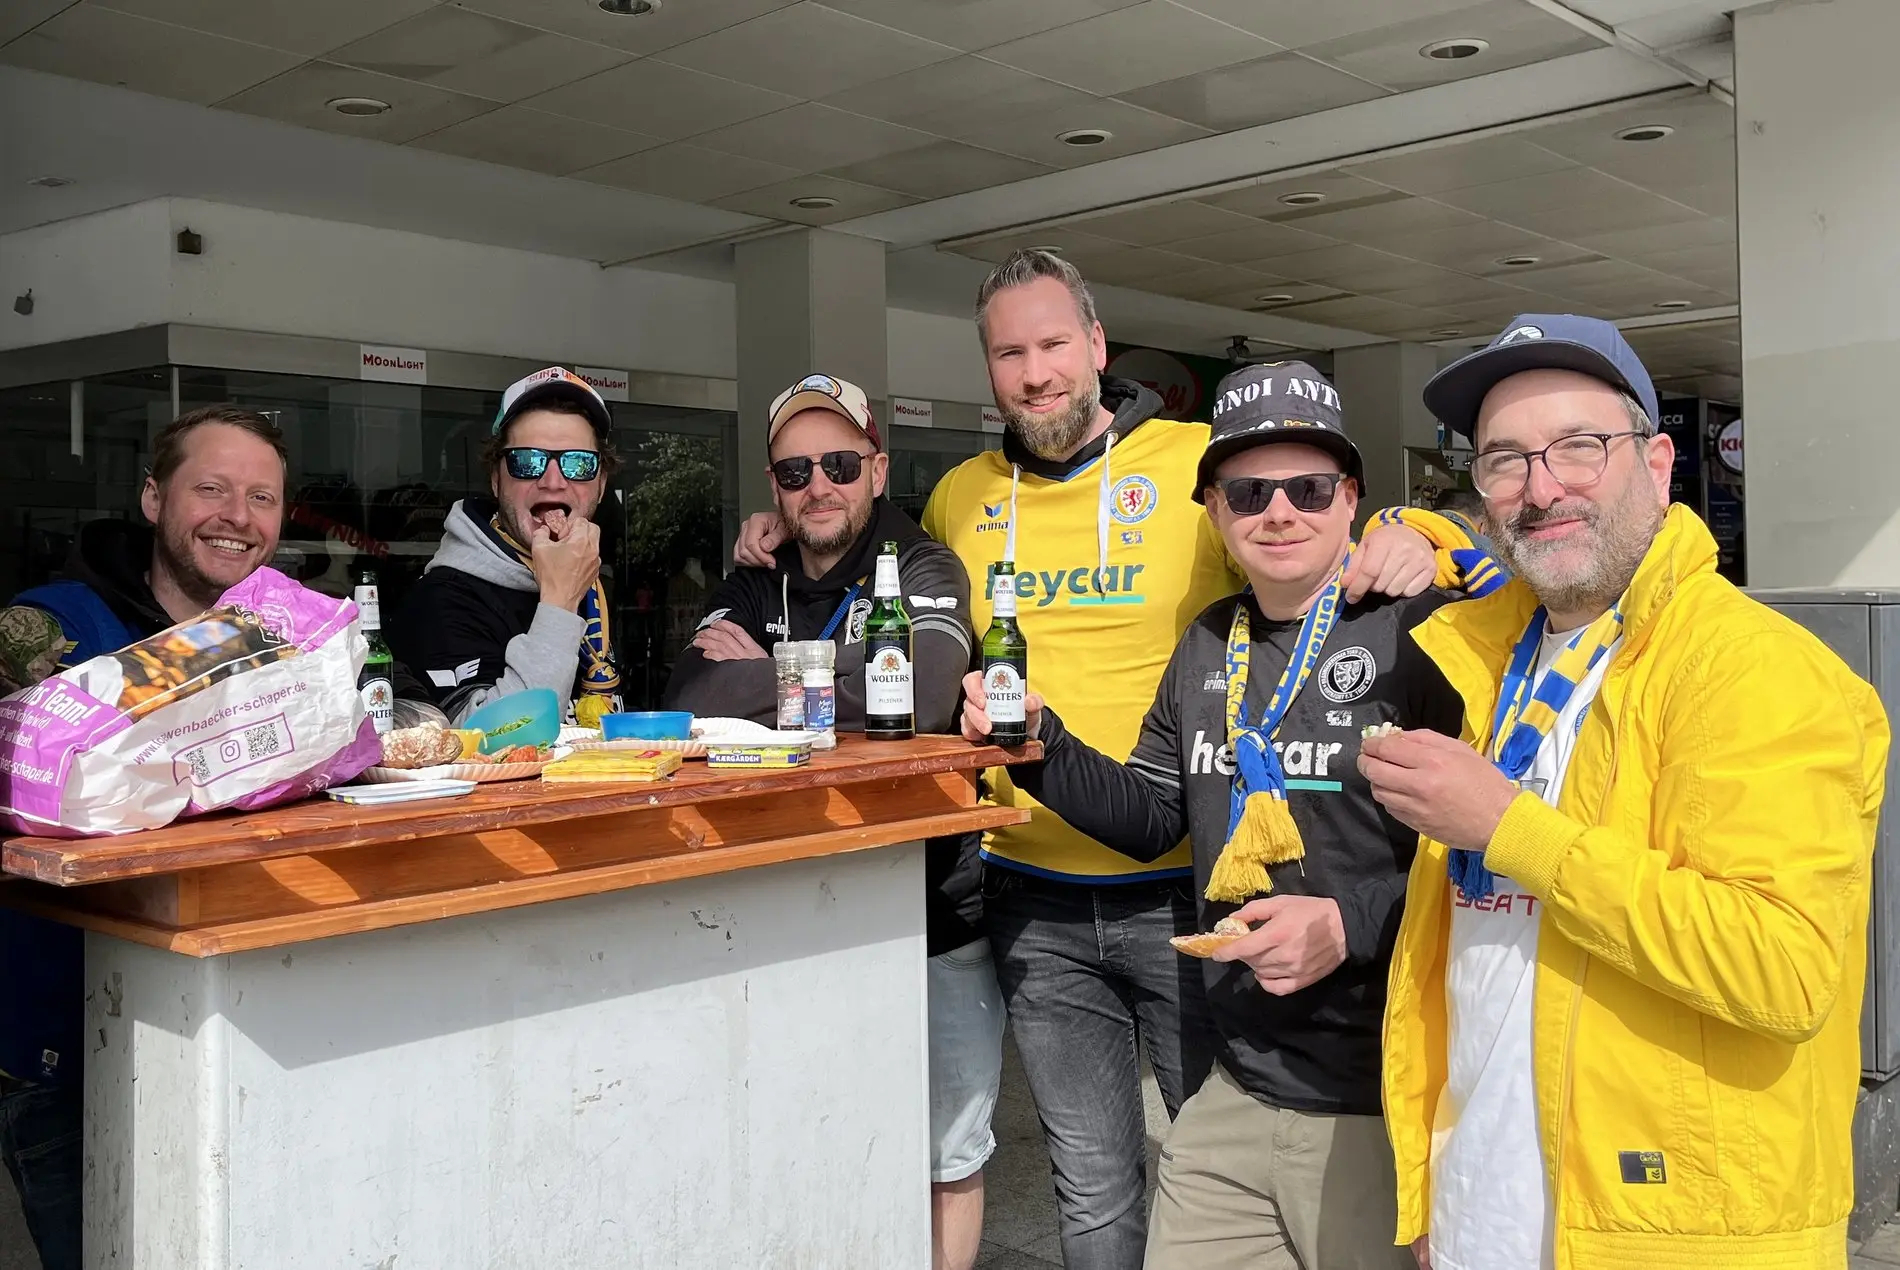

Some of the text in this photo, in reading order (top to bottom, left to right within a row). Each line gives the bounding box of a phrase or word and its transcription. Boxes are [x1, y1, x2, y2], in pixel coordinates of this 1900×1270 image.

[871, 674, 910, 683] WOLTERS
[40, 683, 101, 727] Team!
[365, 709, 393, 719] OLTER
[1189, 730, 1343, 776] hear
